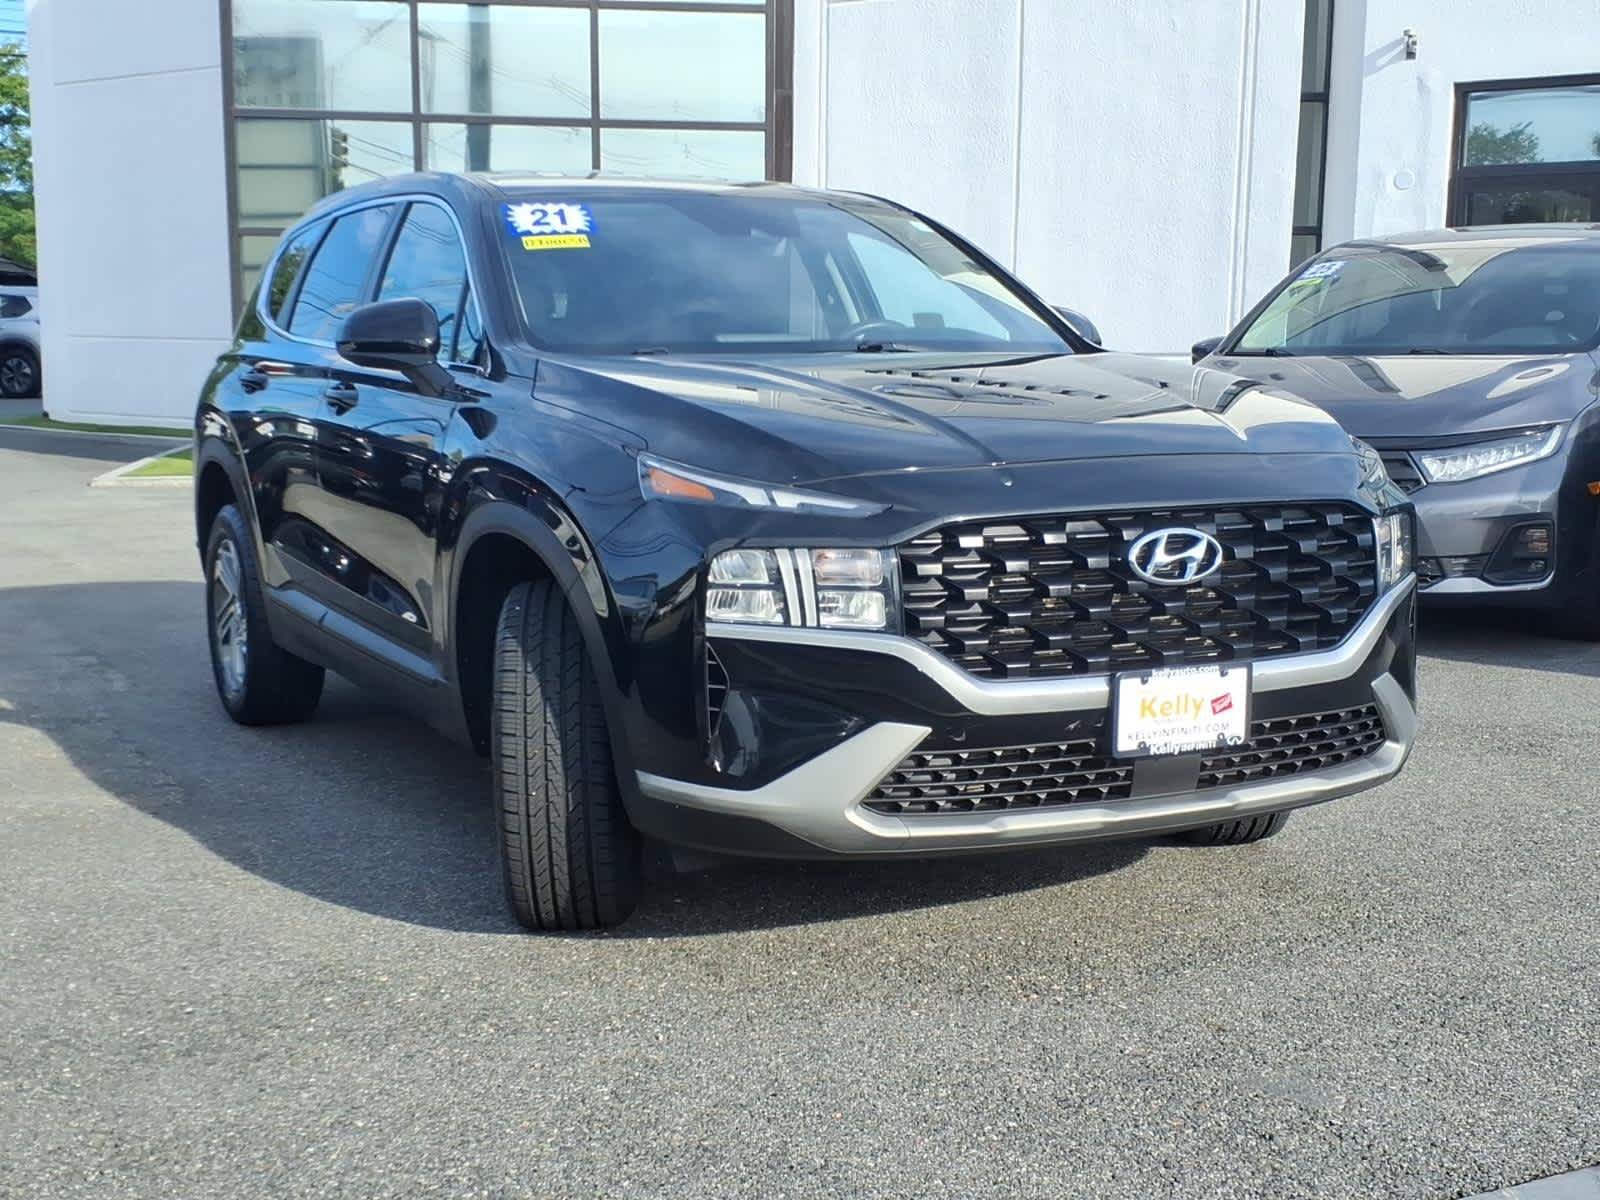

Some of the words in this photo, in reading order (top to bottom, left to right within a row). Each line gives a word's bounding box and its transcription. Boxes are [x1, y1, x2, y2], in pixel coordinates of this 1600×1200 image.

[530, 208, 568, 226] 21
[1140, 693, 1204, 720] Kelly
[1149, 743, 1180, 755] Kelly
